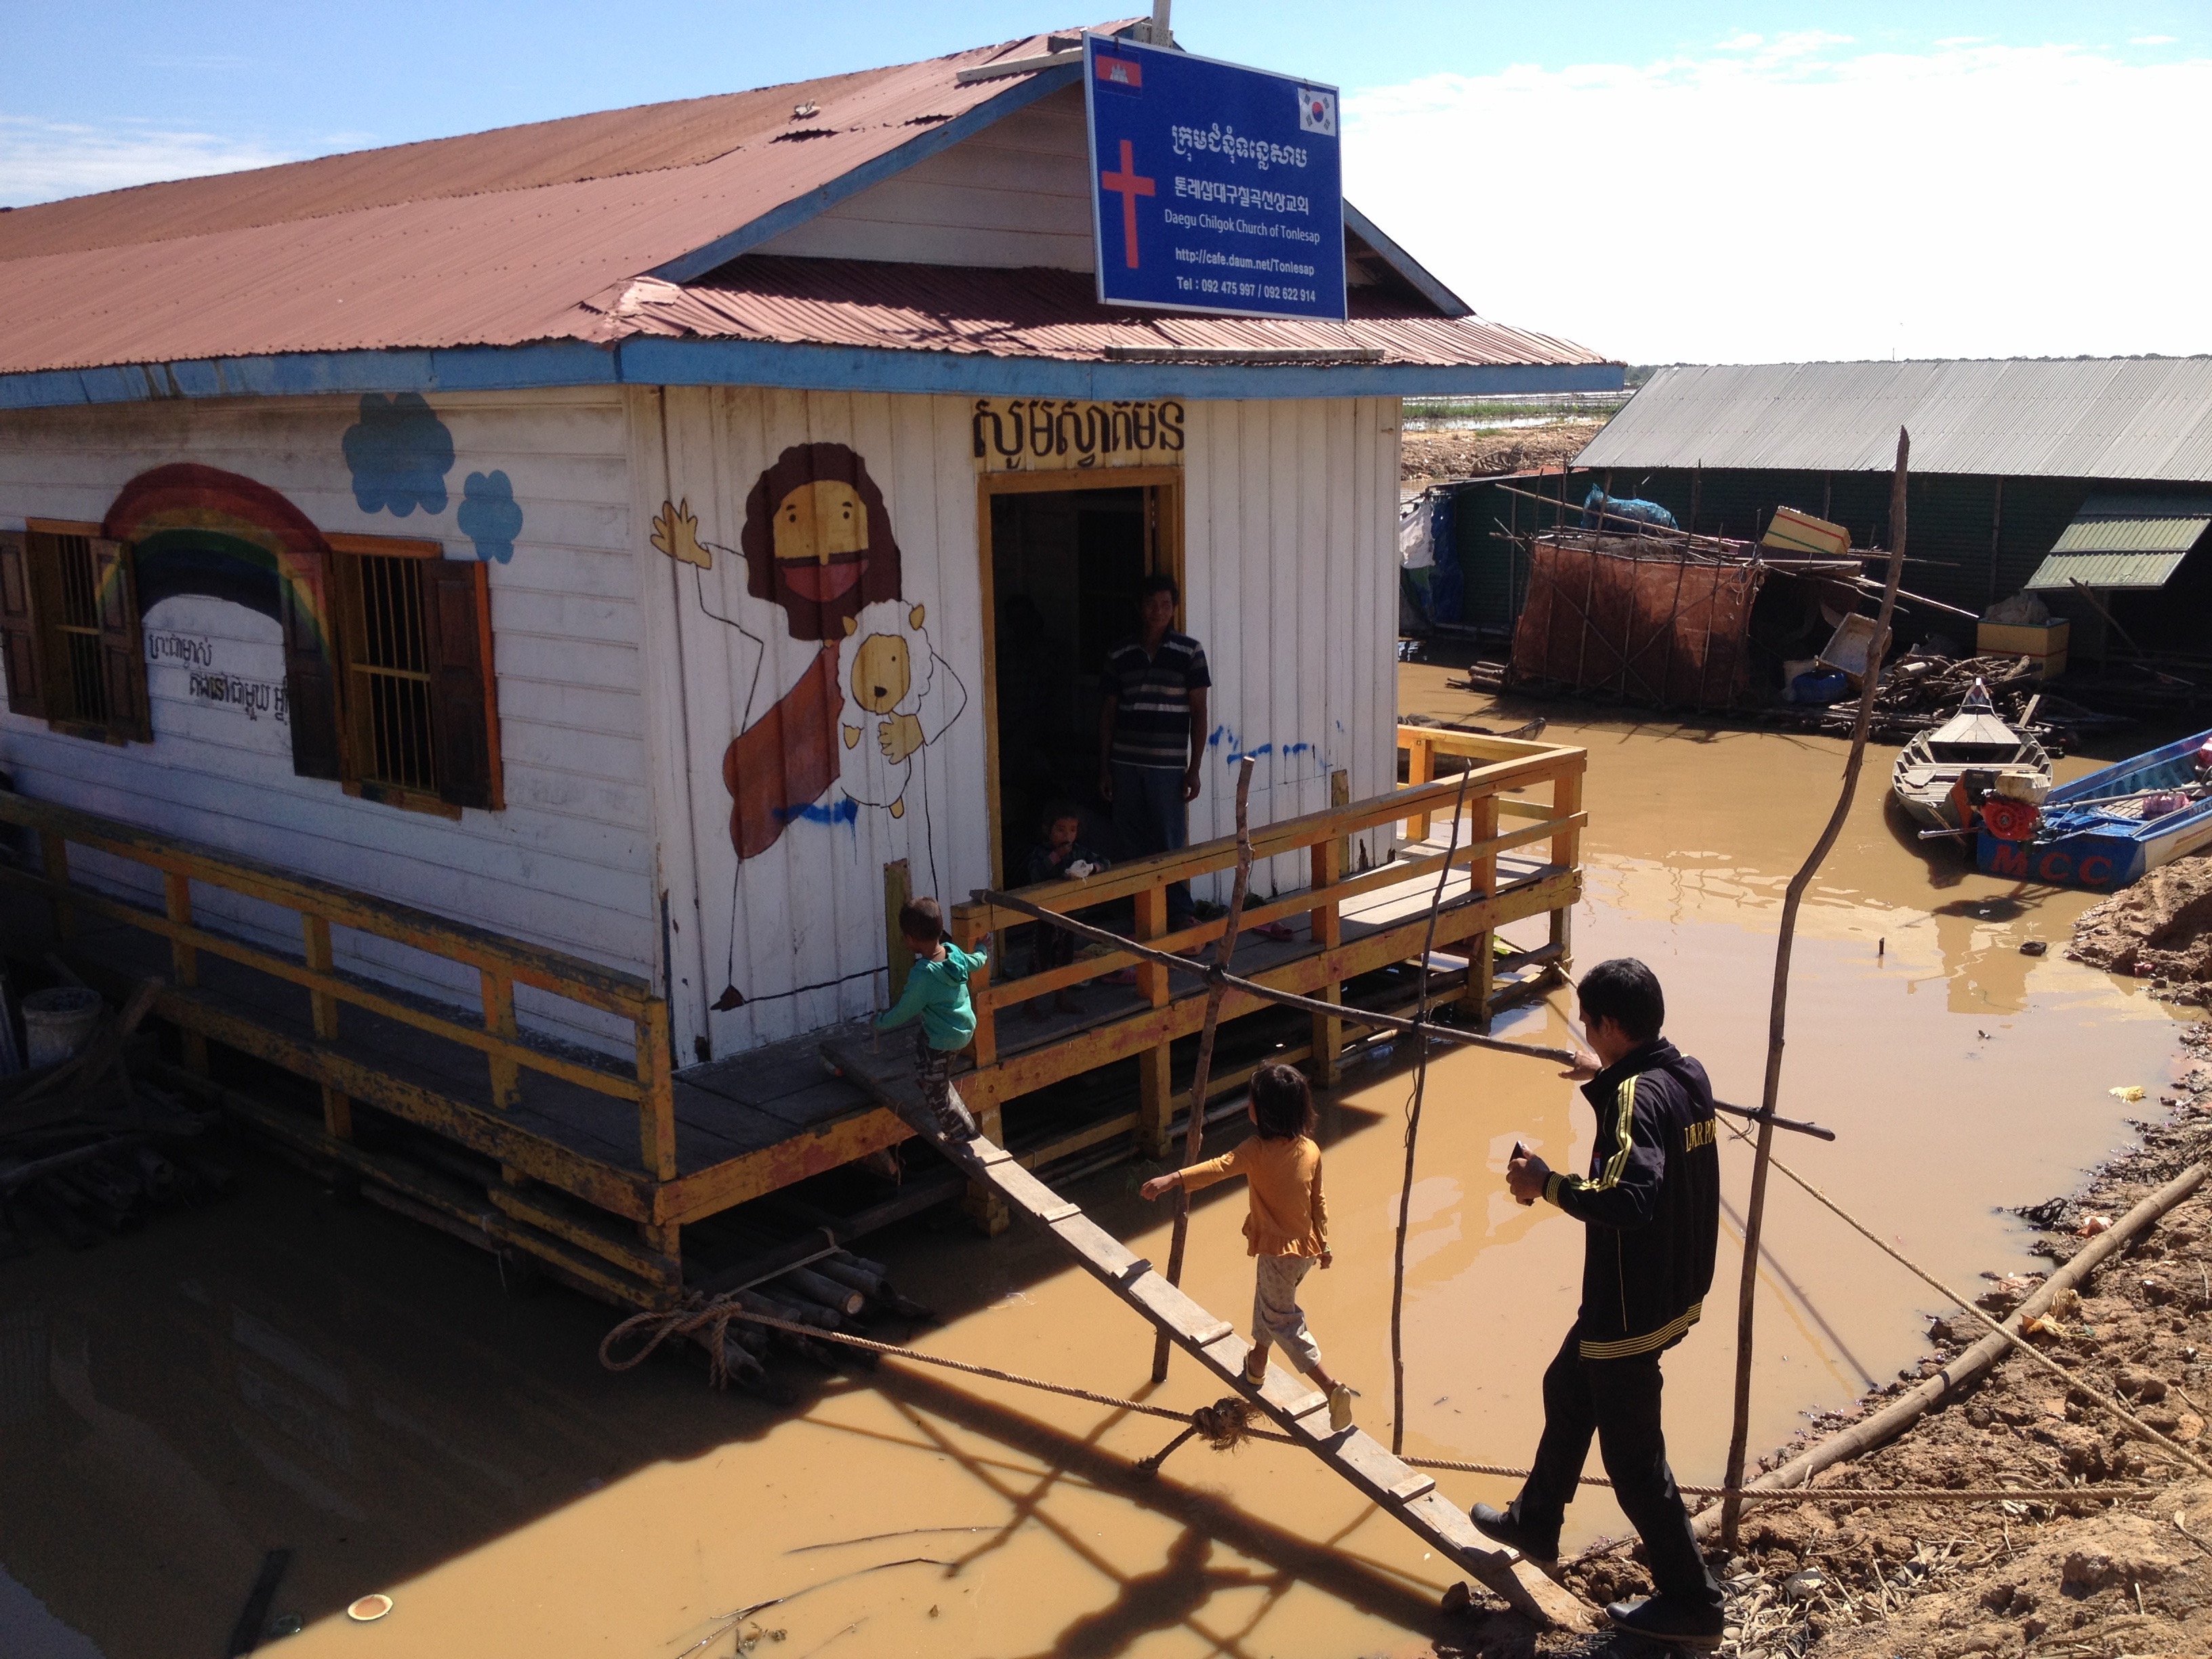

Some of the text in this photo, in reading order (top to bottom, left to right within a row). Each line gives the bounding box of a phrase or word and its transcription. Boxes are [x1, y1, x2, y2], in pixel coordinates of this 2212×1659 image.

[1174, 176, 1309, 216] 톤레삽대구칠곡선상교회
[1164, 209, 1320, 245] Daegu Chilgok Church of Tonlesap
[1175, 247, 1315, 276] http://cafe.daum.net/Tonlesap
[1176, 276, 1193, 290] Tel
[1202, 279, 1218, 293] 092
[1221, 281, 1237, 295] 475
[1240, 283, 1255, 297] 997
[1264, 285, 1280, 299] 092
[1282, 287, 1298, 301] 622
[1300, 289, 1315, 302] 914
